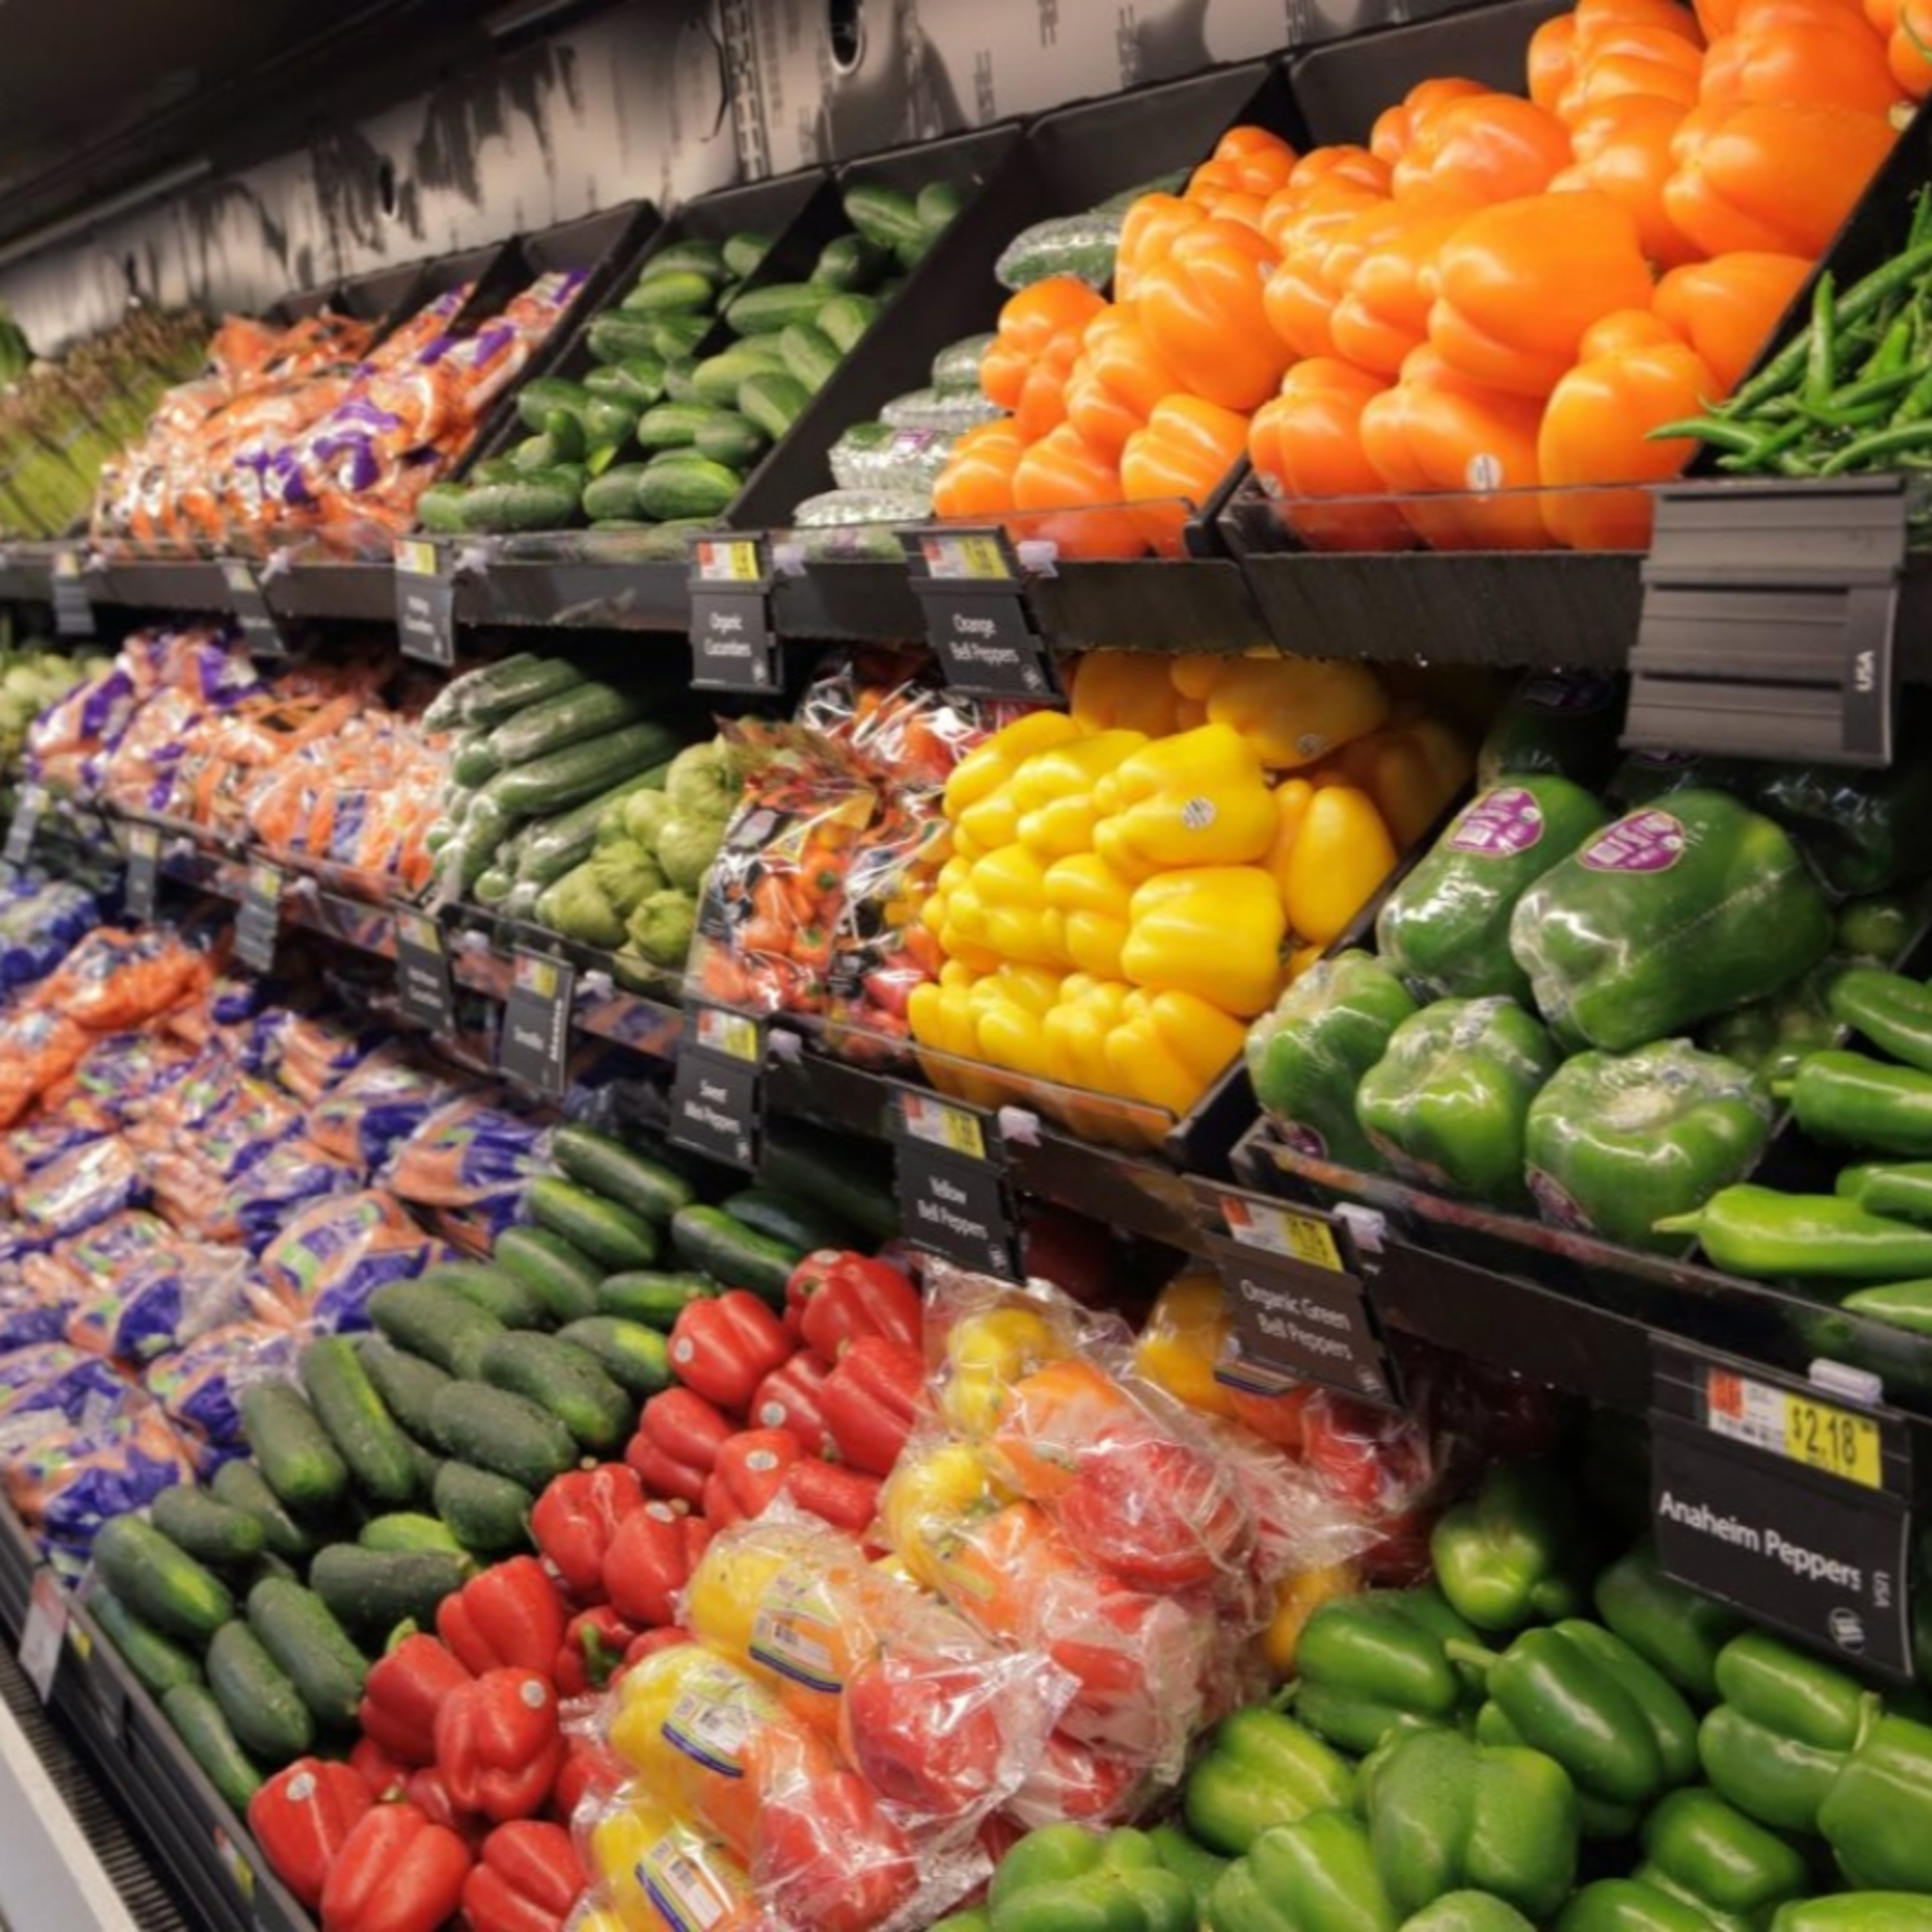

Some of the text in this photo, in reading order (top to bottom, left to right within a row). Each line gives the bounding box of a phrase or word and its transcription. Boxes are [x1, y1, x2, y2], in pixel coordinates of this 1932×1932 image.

[1855, 650, 1875, 691] USA
[1240, 1280, 1350, 1331] Organic Green
[1257, 1312, 1354, 1361] Bell Peppers
[1792, 1405, 1857, 1467] $2.18
[1659, 1492, 1862, 1590] Anaheim Peppers
[1873, 1571, 1891, 1607] USA
